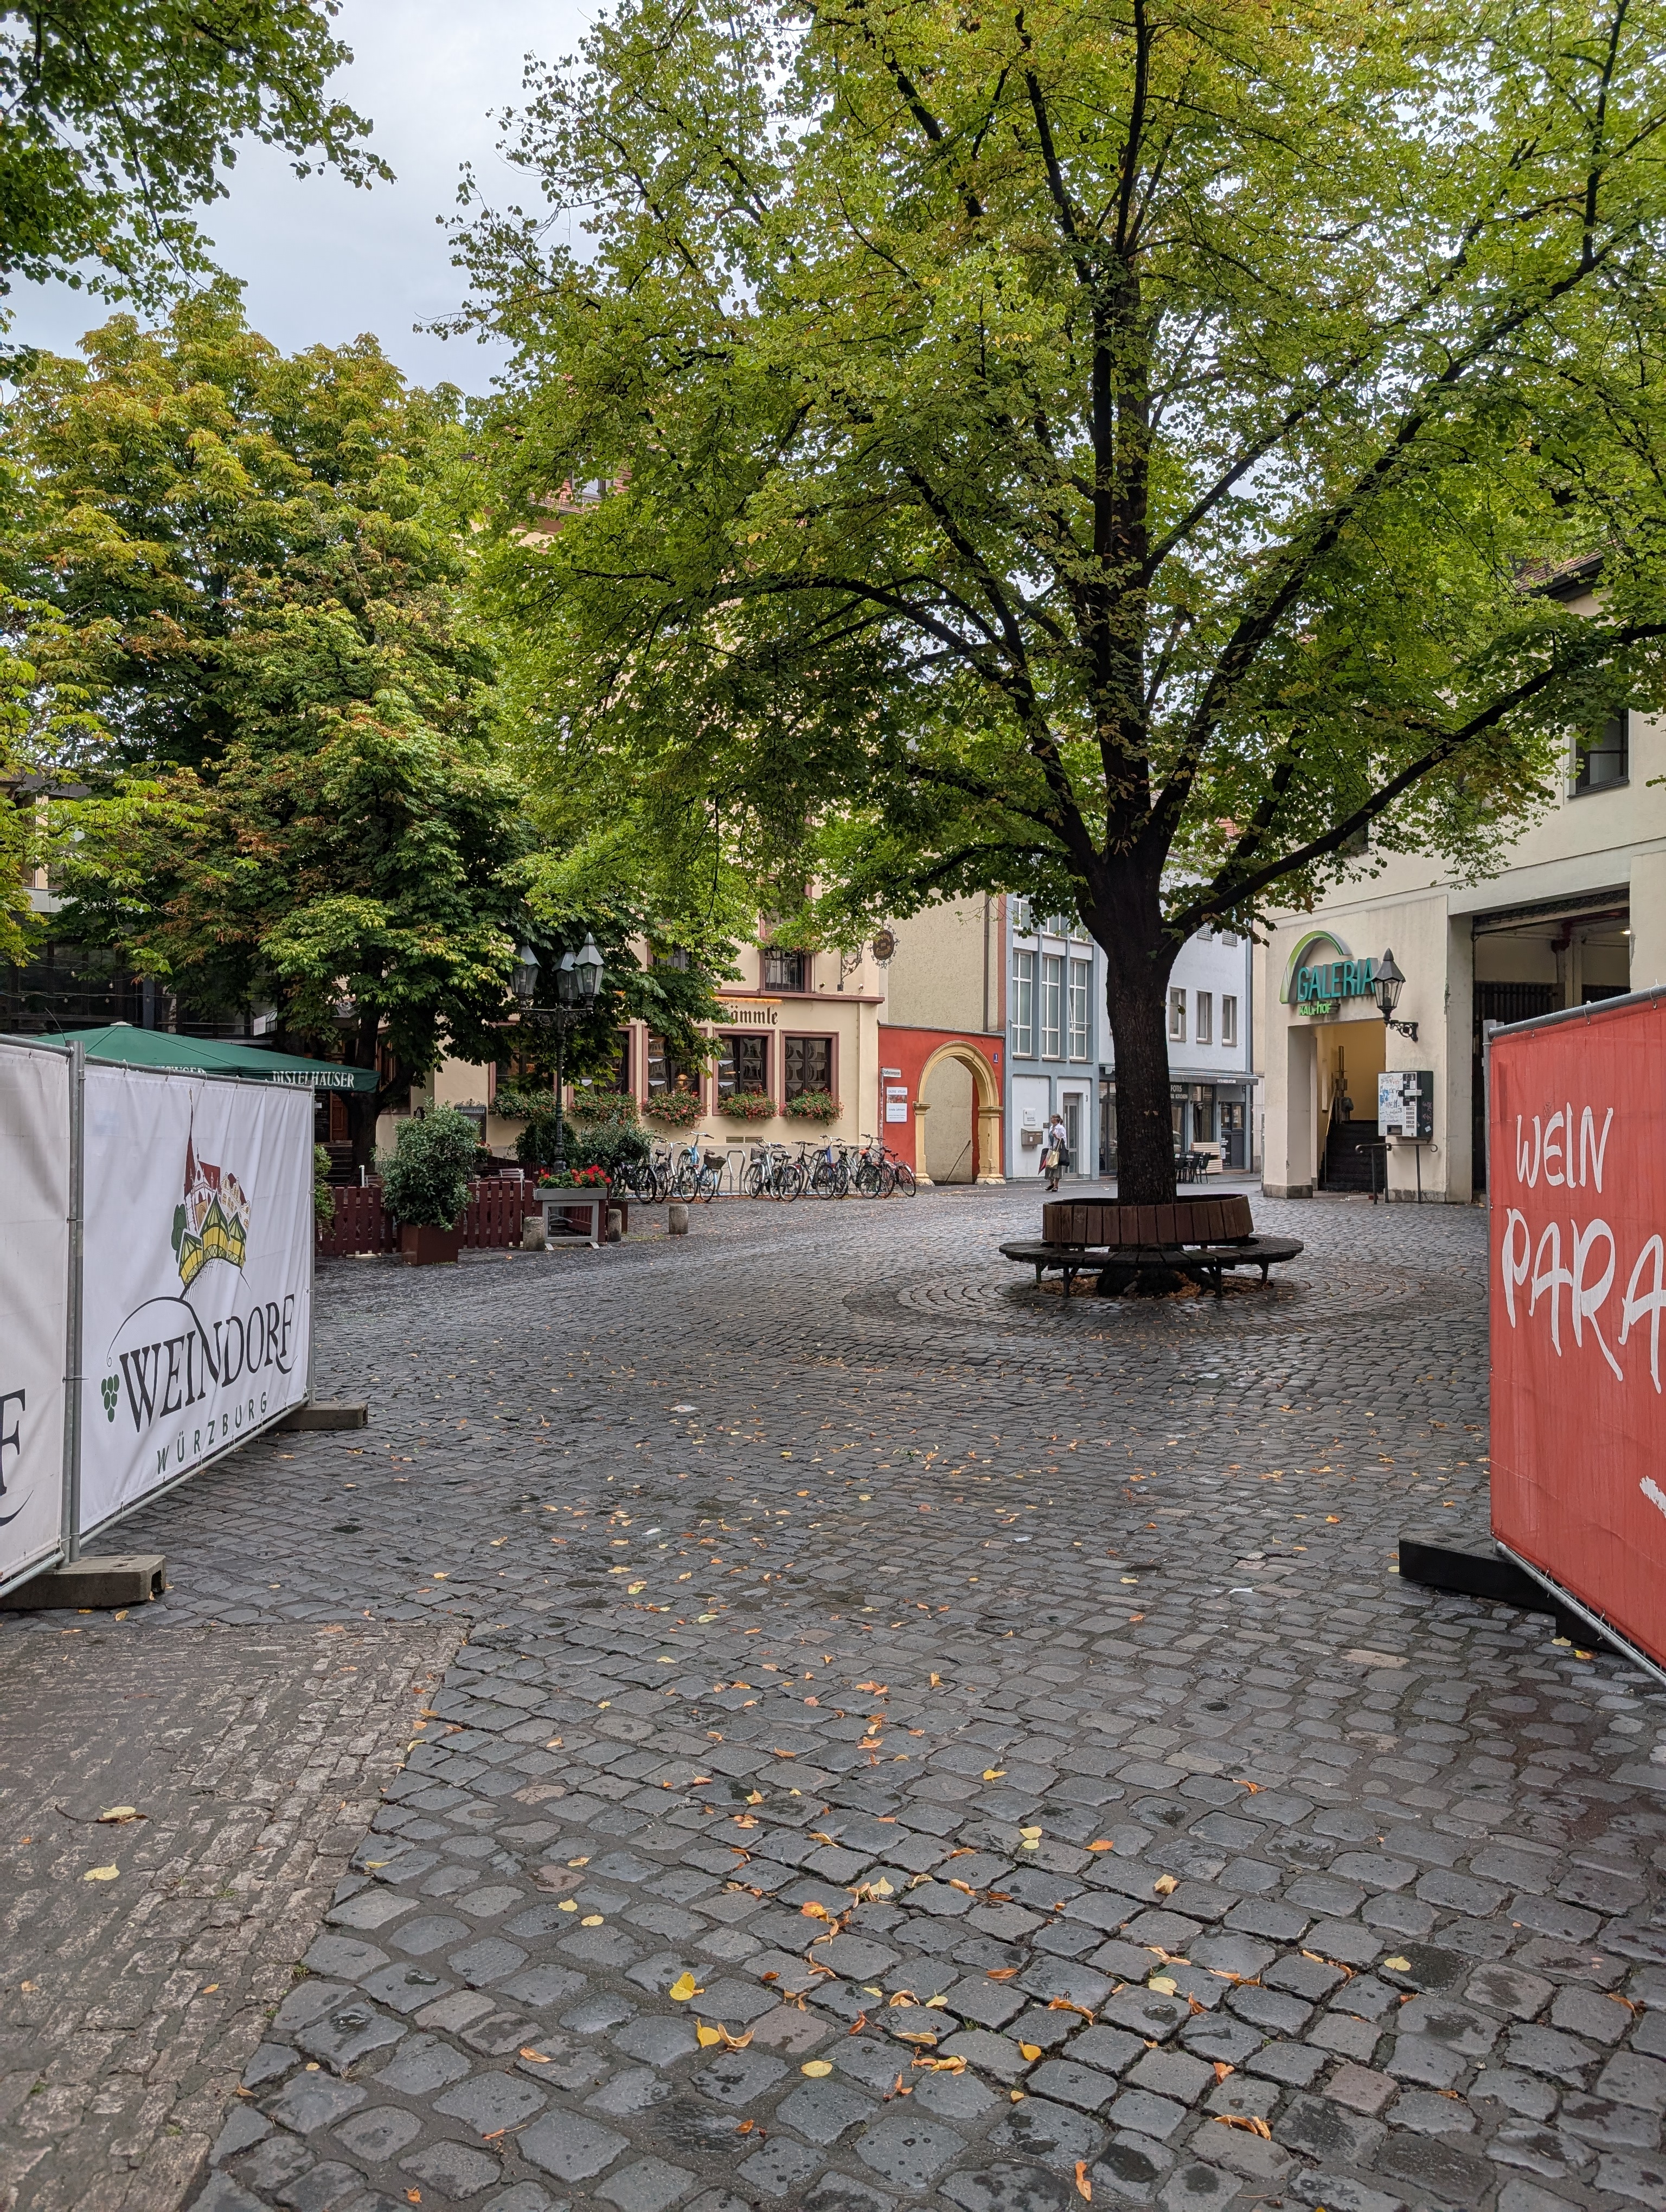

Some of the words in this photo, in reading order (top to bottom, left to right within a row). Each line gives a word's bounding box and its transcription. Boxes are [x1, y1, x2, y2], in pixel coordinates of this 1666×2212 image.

[717, 1001, 778, 1025] ämmle
[1298, 957, 1375, 1000] GALERIA
[1517, 1102, 1613, 1193] WEIN
[1501, 1208, 1666, 1394] PARA
[119, 1294, 298, 1433] WEINDORF
[157, 1391, 267, 1475] WÜRZBURG
